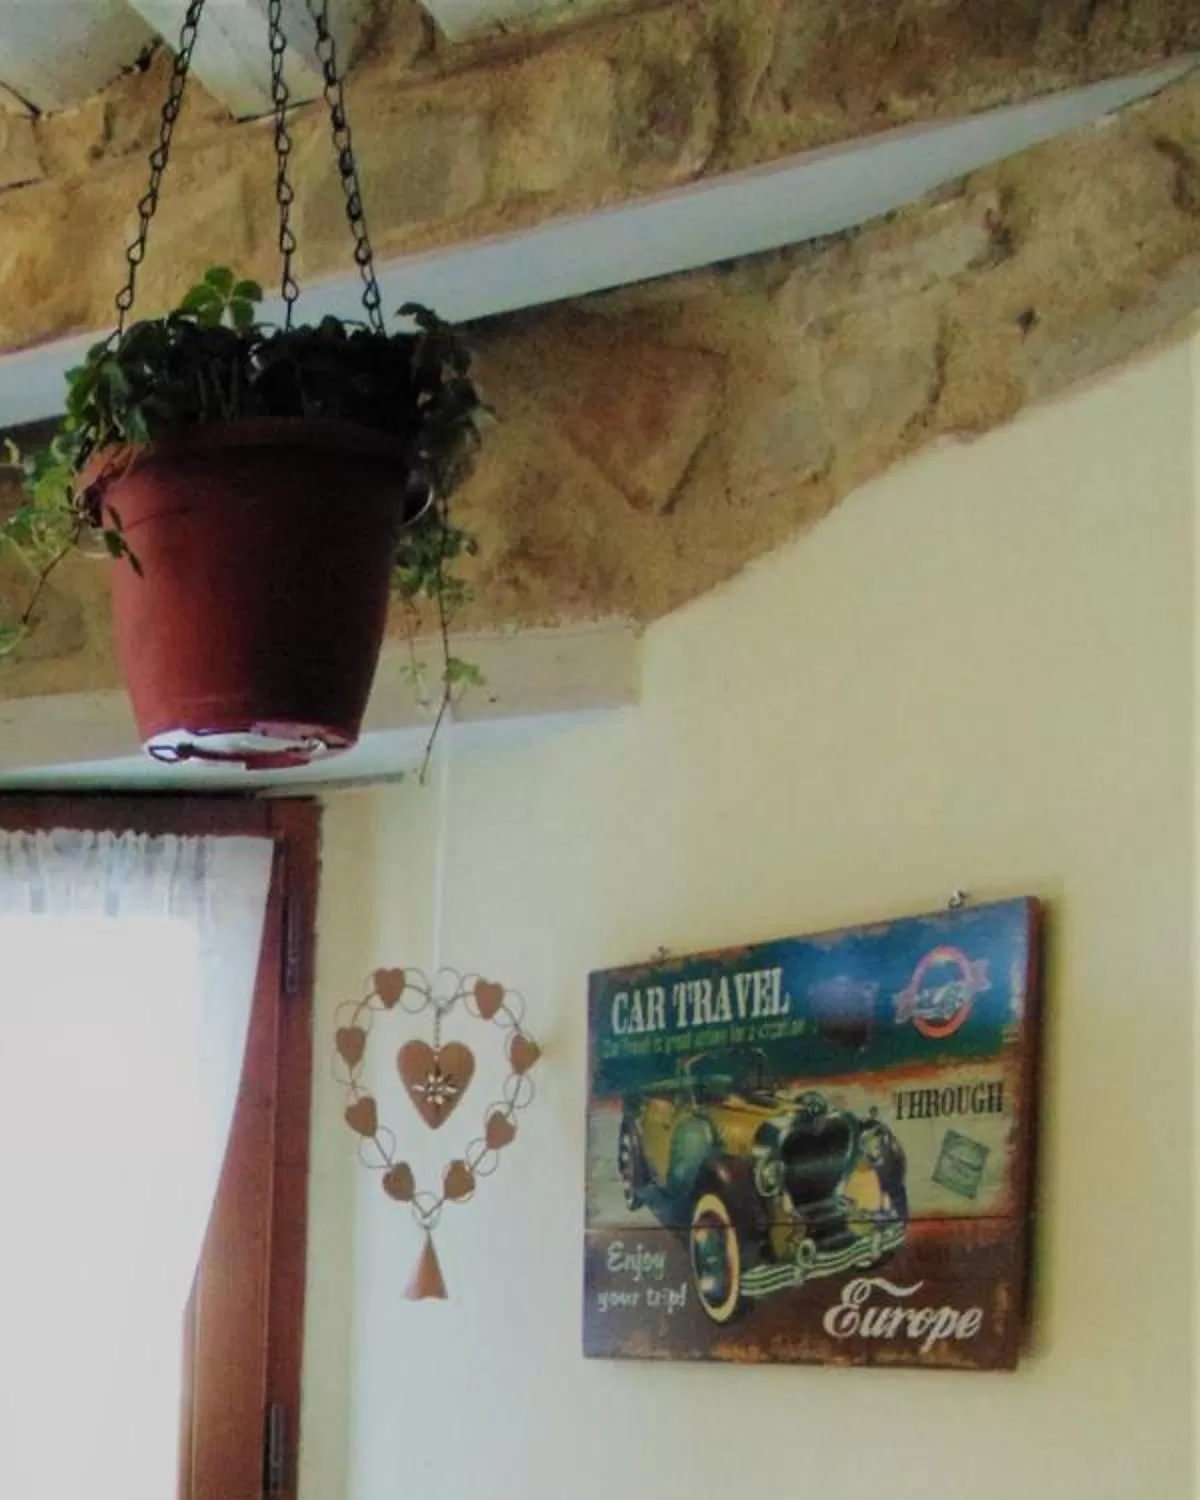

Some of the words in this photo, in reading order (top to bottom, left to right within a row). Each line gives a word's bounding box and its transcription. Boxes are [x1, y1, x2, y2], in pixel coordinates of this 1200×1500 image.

[612, 985, 667, 1036] CAR
[673, 967, 791, 1029] TRAVEL
[896, 1082, 1004, 1121] THROUGH
[607, 1241, 667, 1282] Enjoy
[597, 1290, 640, 1313] your
[823, 1277, 984, 1353] Europe
